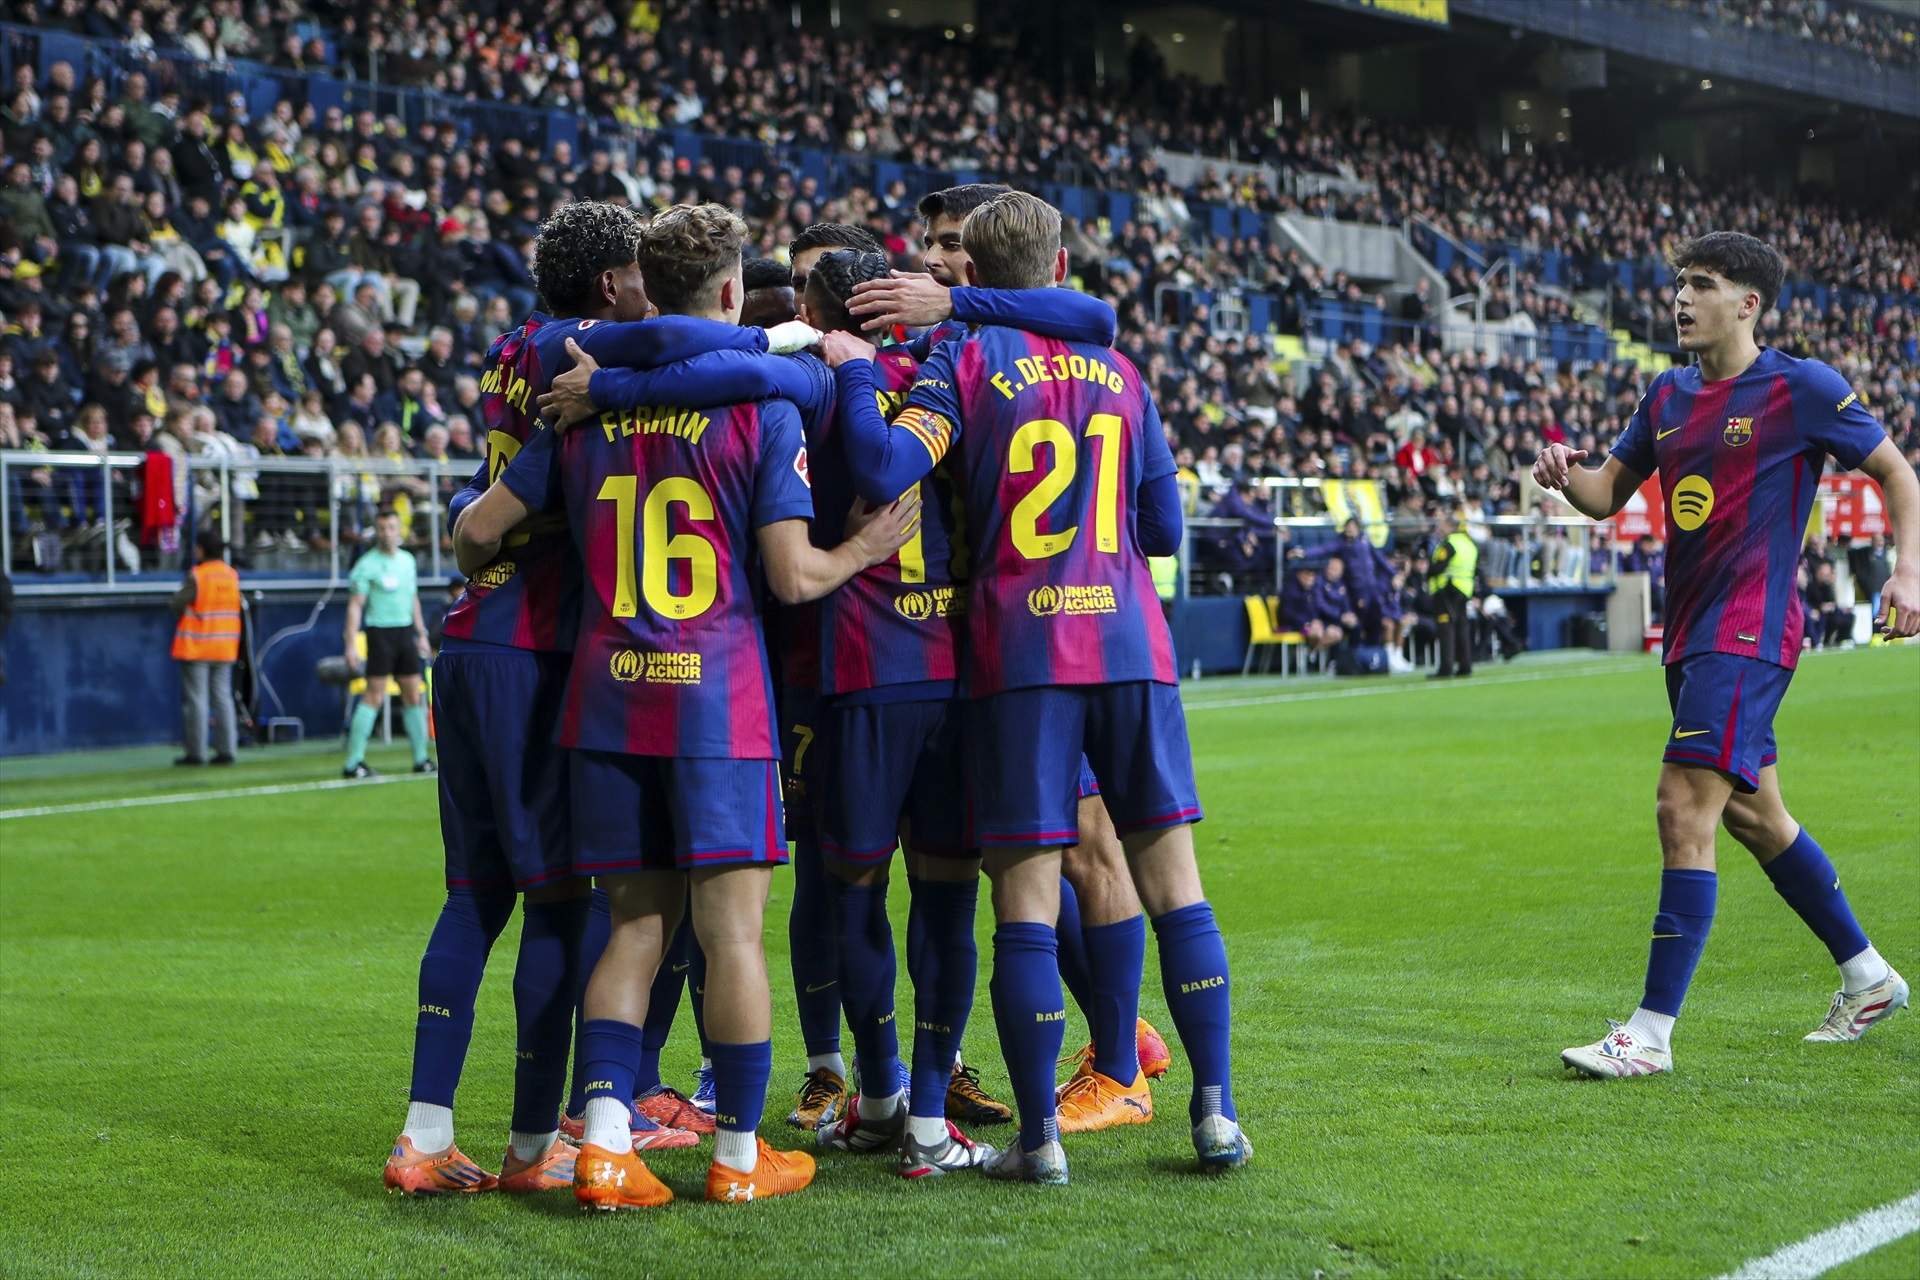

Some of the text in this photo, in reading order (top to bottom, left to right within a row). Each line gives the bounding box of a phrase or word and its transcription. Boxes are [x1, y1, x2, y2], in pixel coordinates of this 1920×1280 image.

[1009, 413, 1122, 559] 21
[596, 475, 718, 620] 16
[1064, 585, 1114, 598] UNHCR
[1063, 597, 1116, 610] ACNUR
[646, 651, 701, 666] UNHCR
[645, 665, 701, 679] ACNUR
[792, 724, 814, 775] 7
